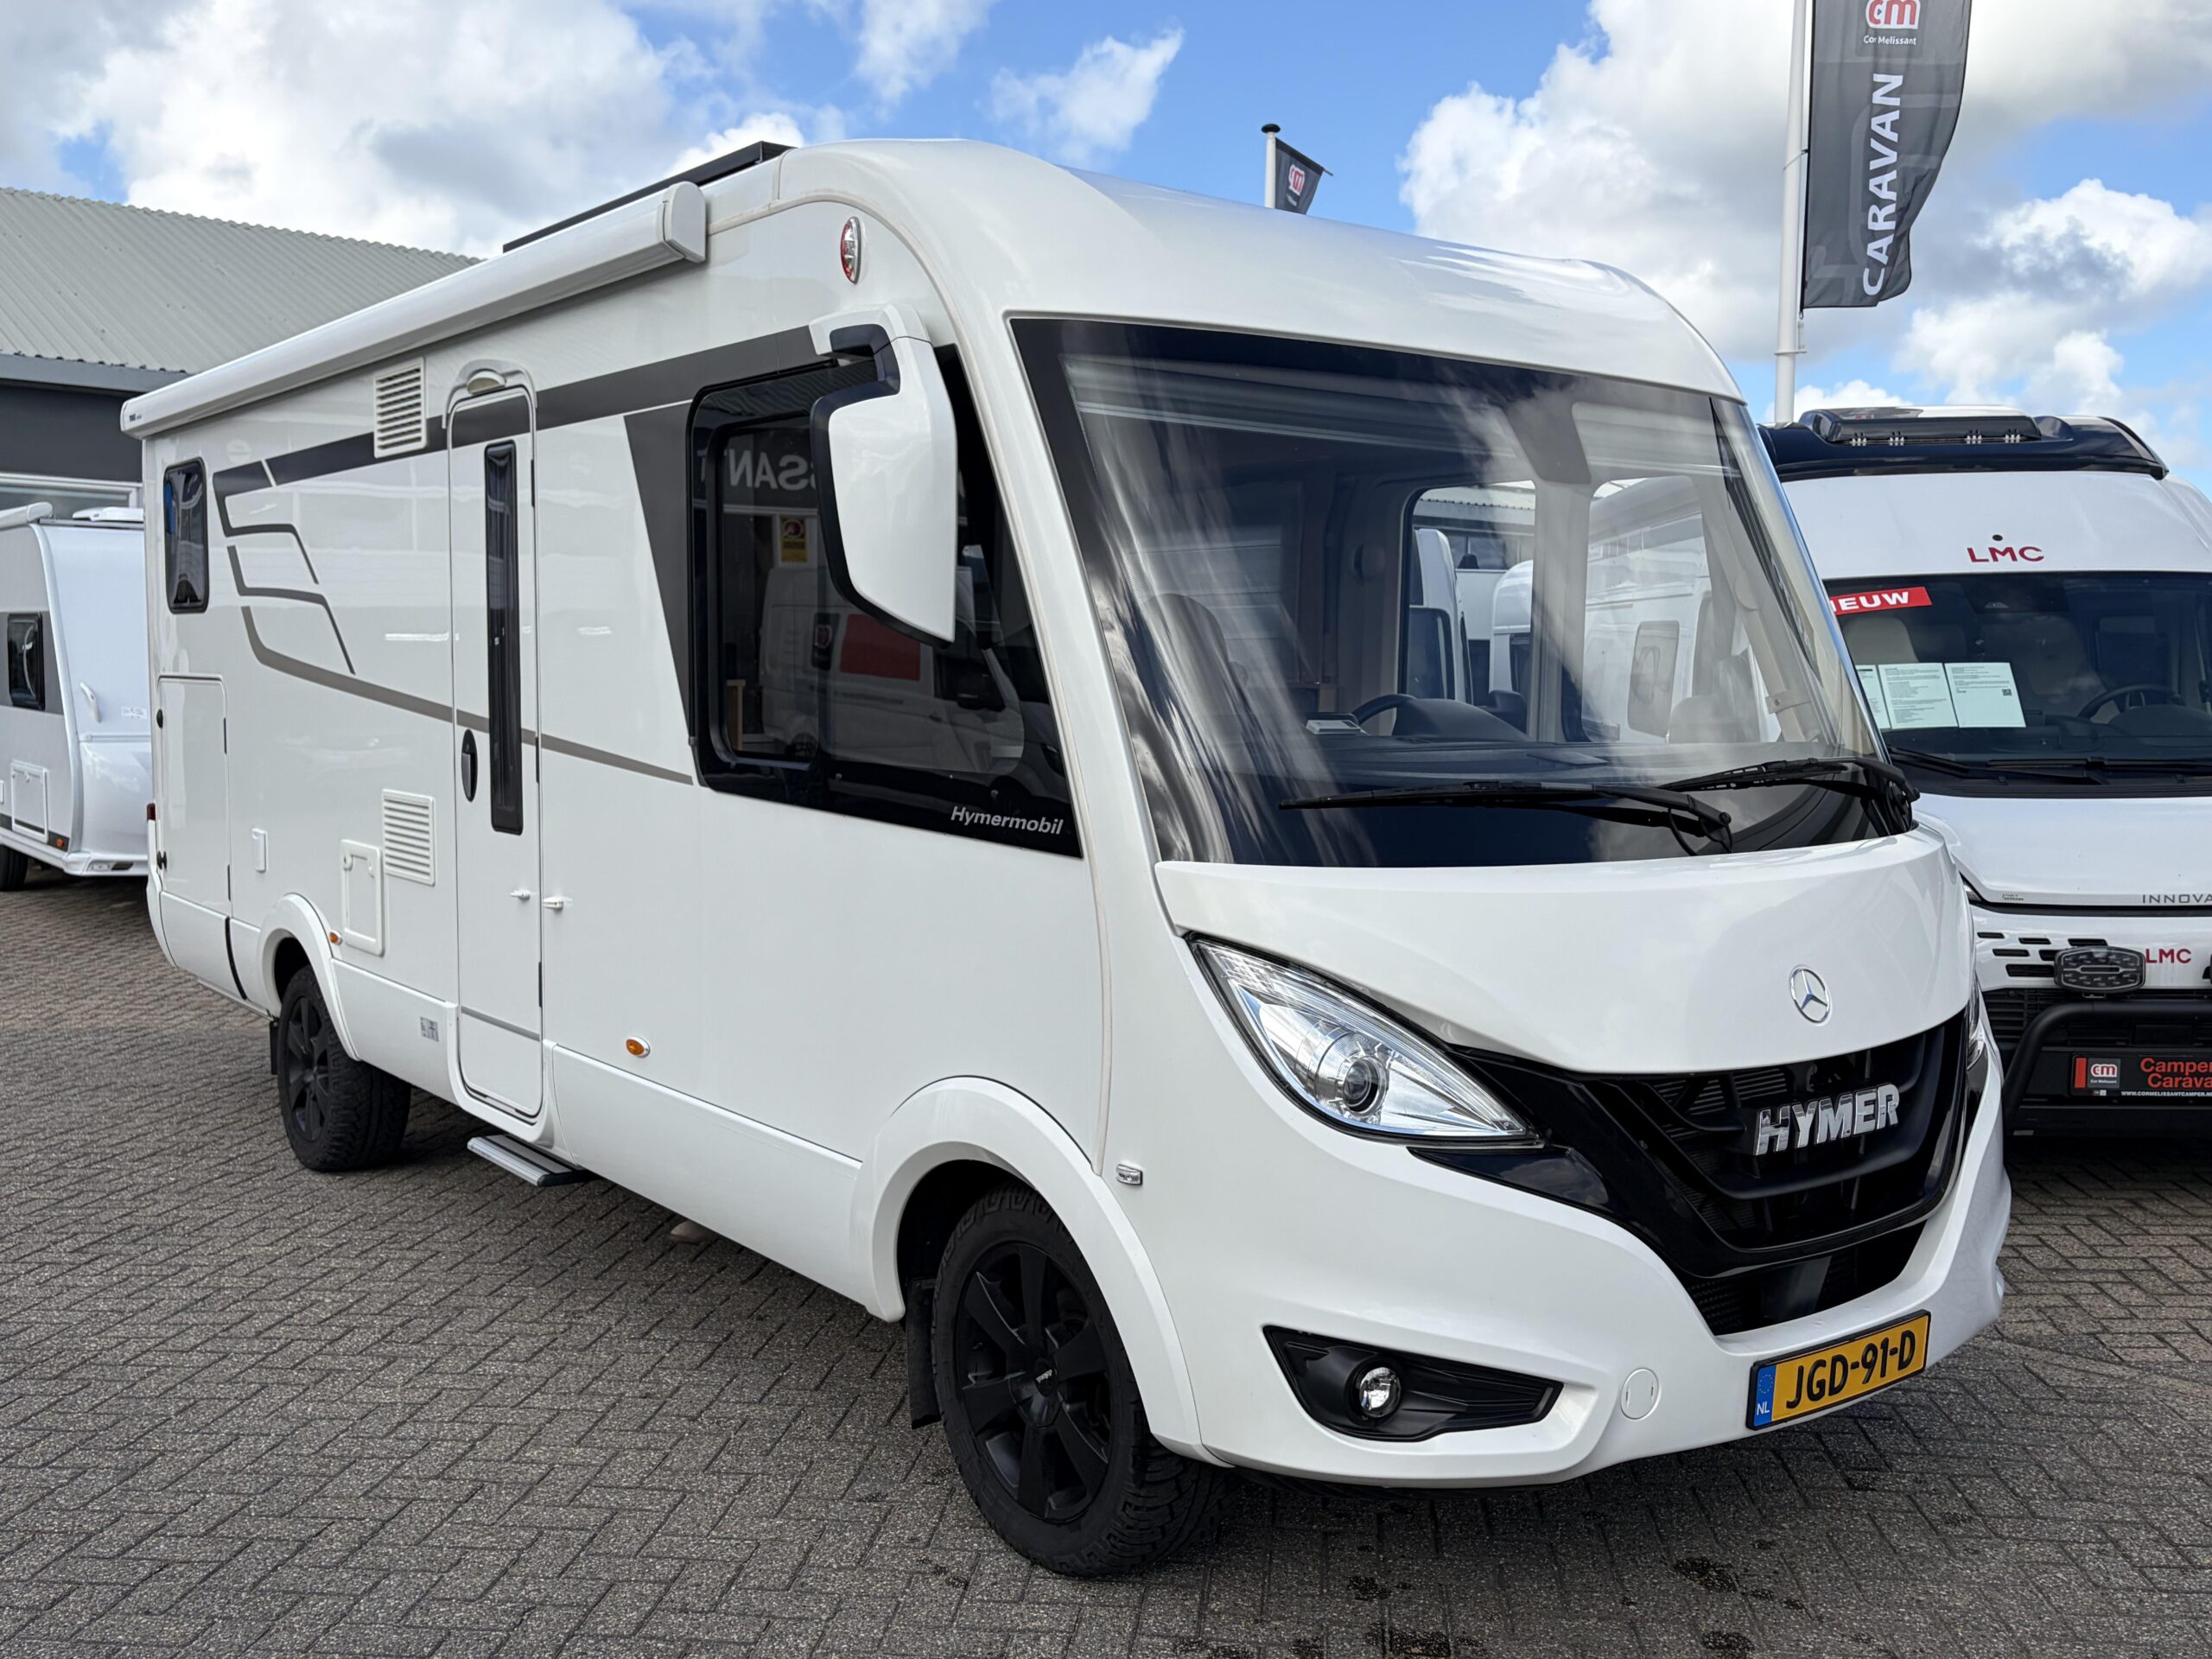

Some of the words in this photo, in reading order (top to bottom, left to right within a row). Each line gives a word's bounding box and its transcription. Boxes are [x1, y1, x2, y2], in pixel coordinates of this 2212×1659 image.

[1878, 35, 1916, 45] Melissant
[1863, 73, 1904, 296] CARAVAN
[1967, 546, 2045, 563] LMC
[950, 805, 1064, 835] Hymermobil
[2145, 948, 2192, 963] LMC
[1756, 1083, 1899, 1156] HYMER
[1785, 1330, 1916, 1409] JGD-91-D
[1756, 1401, 1770, 1416] NL
